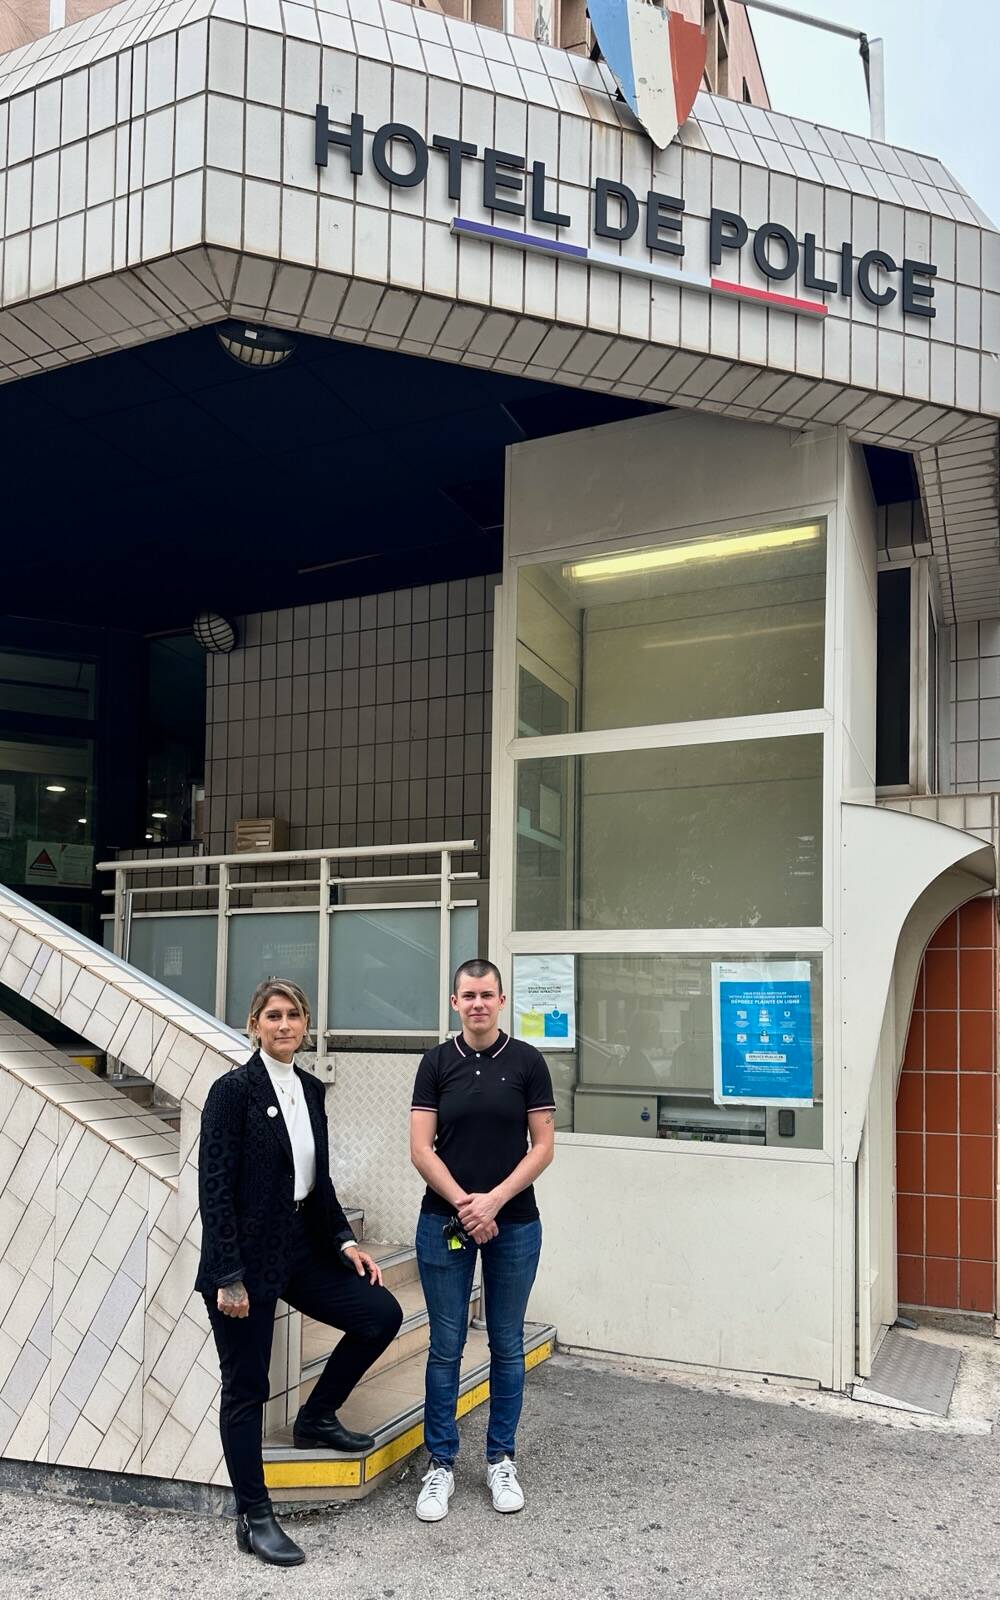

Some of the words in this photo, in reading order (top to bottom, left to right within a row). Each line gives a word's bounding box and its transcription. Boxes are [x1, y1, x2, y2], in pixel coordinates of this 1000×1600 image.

[315, 103, 571, 227] HOTEL
[595, 177, 686, 257] DE
[710, 208, 938, 318] POLICE
